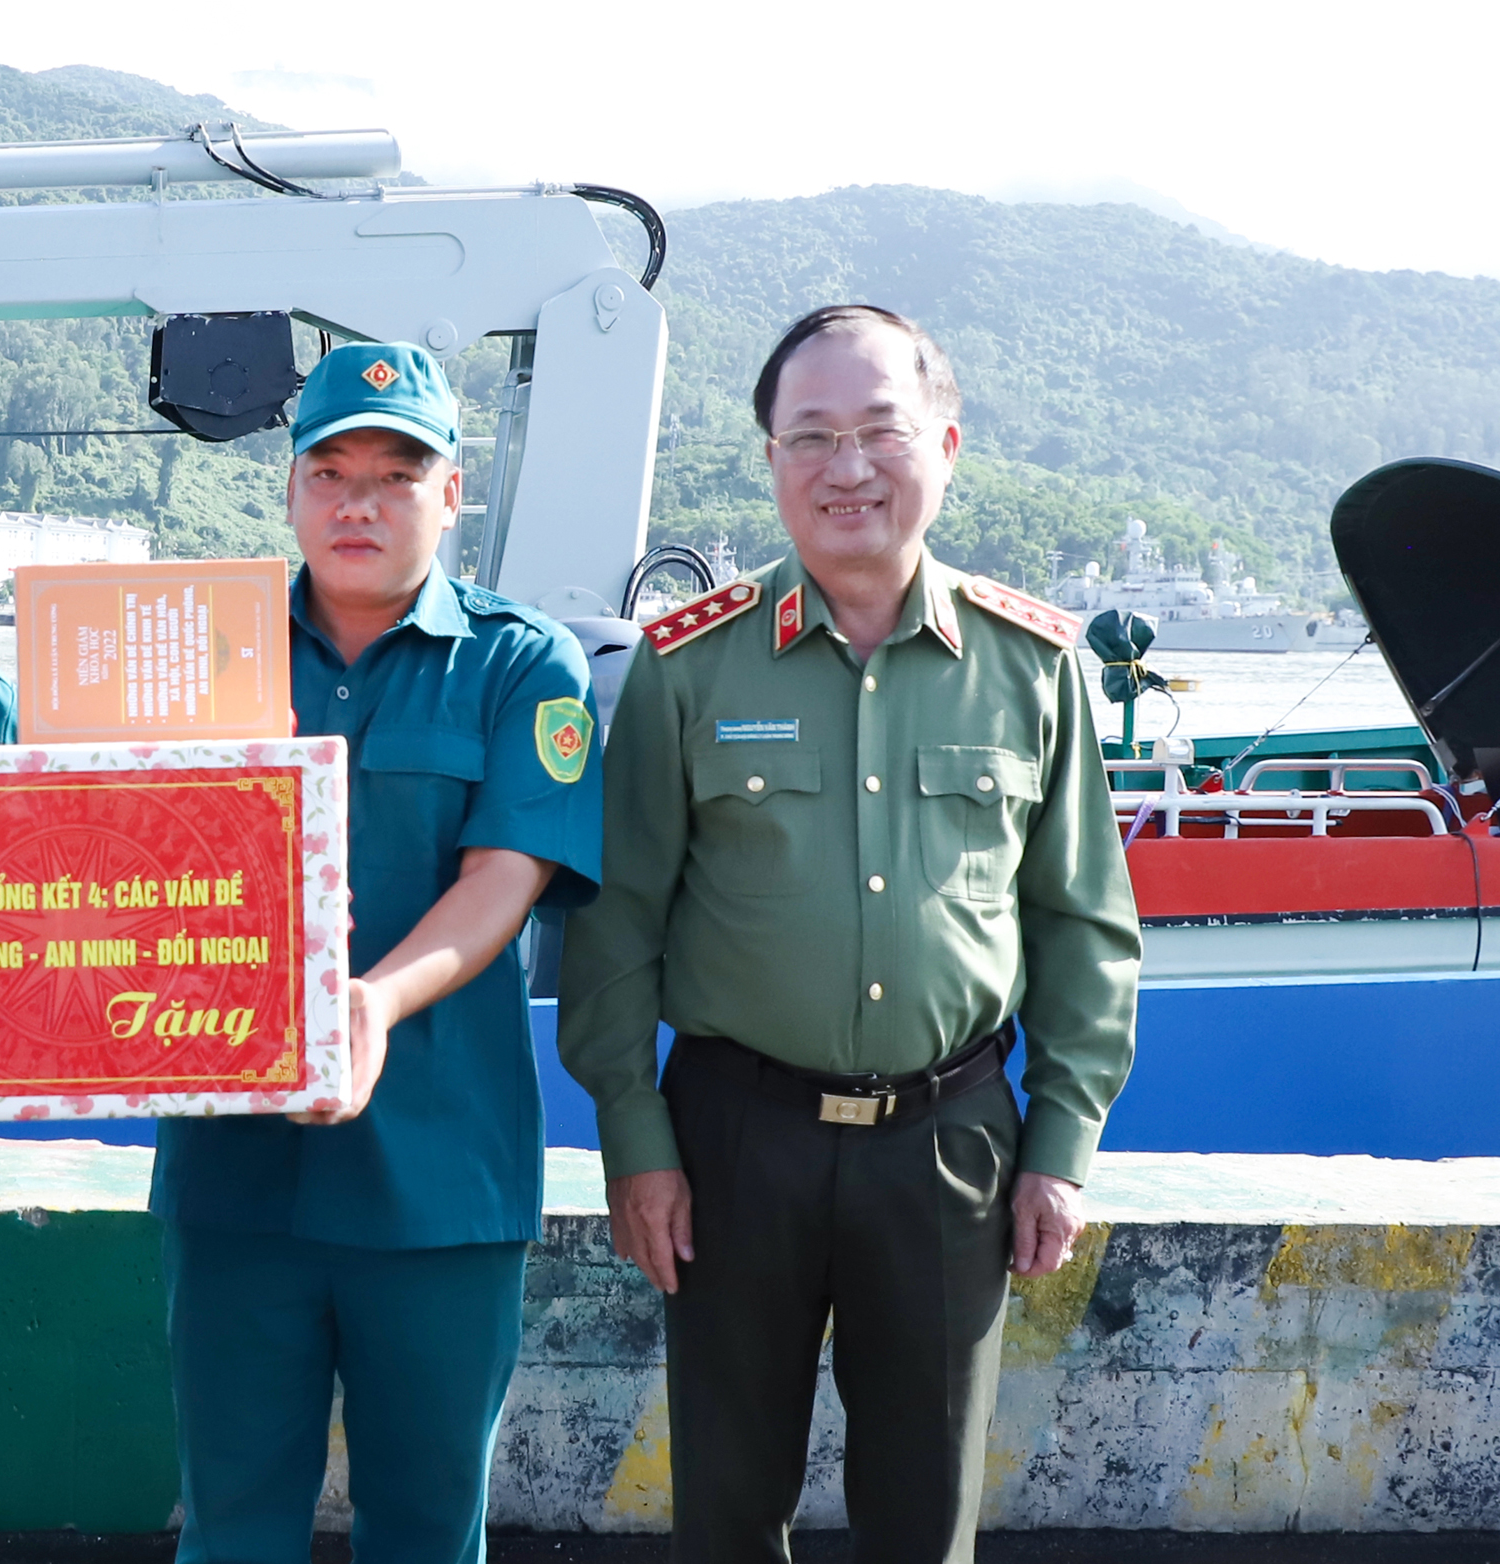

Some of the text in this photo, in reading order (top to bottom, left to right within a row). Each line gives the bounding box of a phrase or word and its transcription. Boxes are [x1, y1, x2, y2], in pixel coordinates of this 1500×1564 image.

[126, 593, 138, 609] TRỊ
[140, 604, 152, 617] TẾ
[142, 618, 152, 643] KINH
[197, 604, 209, 634] NGOẠI
[183, 621, 195, 646] QUỐC
[1252, 624, 1274, 640] 20
[89, 627, 101, 684] KHOA HỌC
[103, 629, 117, 661] 2022
[169, 641, 180, 663] CON
[76, 658, 89, 686] NIÊN
[125, 659, 138, 681] VẤN
[141, 659, 153, 681] VẤN
[155, 658, 168, 679] VẤN
[183, 662, 195, 682] VẤN
[198, 653, 209, 679] NINH,
[198, 681, 209, 695] AN
[41, 873, 82, 909] KẾT
[88, 884, 108, 908] 4:
[114, 874, 159, 908] CÁC
[164, 869, 209, 907] VẤN
[215, 869, 244, 906] ĐỀ
[44, 940, 76, 967] AN
[81, 939, 137, 967] NINH
[157, 928, 194, 966] ĐỐI
[200, 936, 269, 970] NGOẠI
[106, 990, 260, 1047] Tặng
